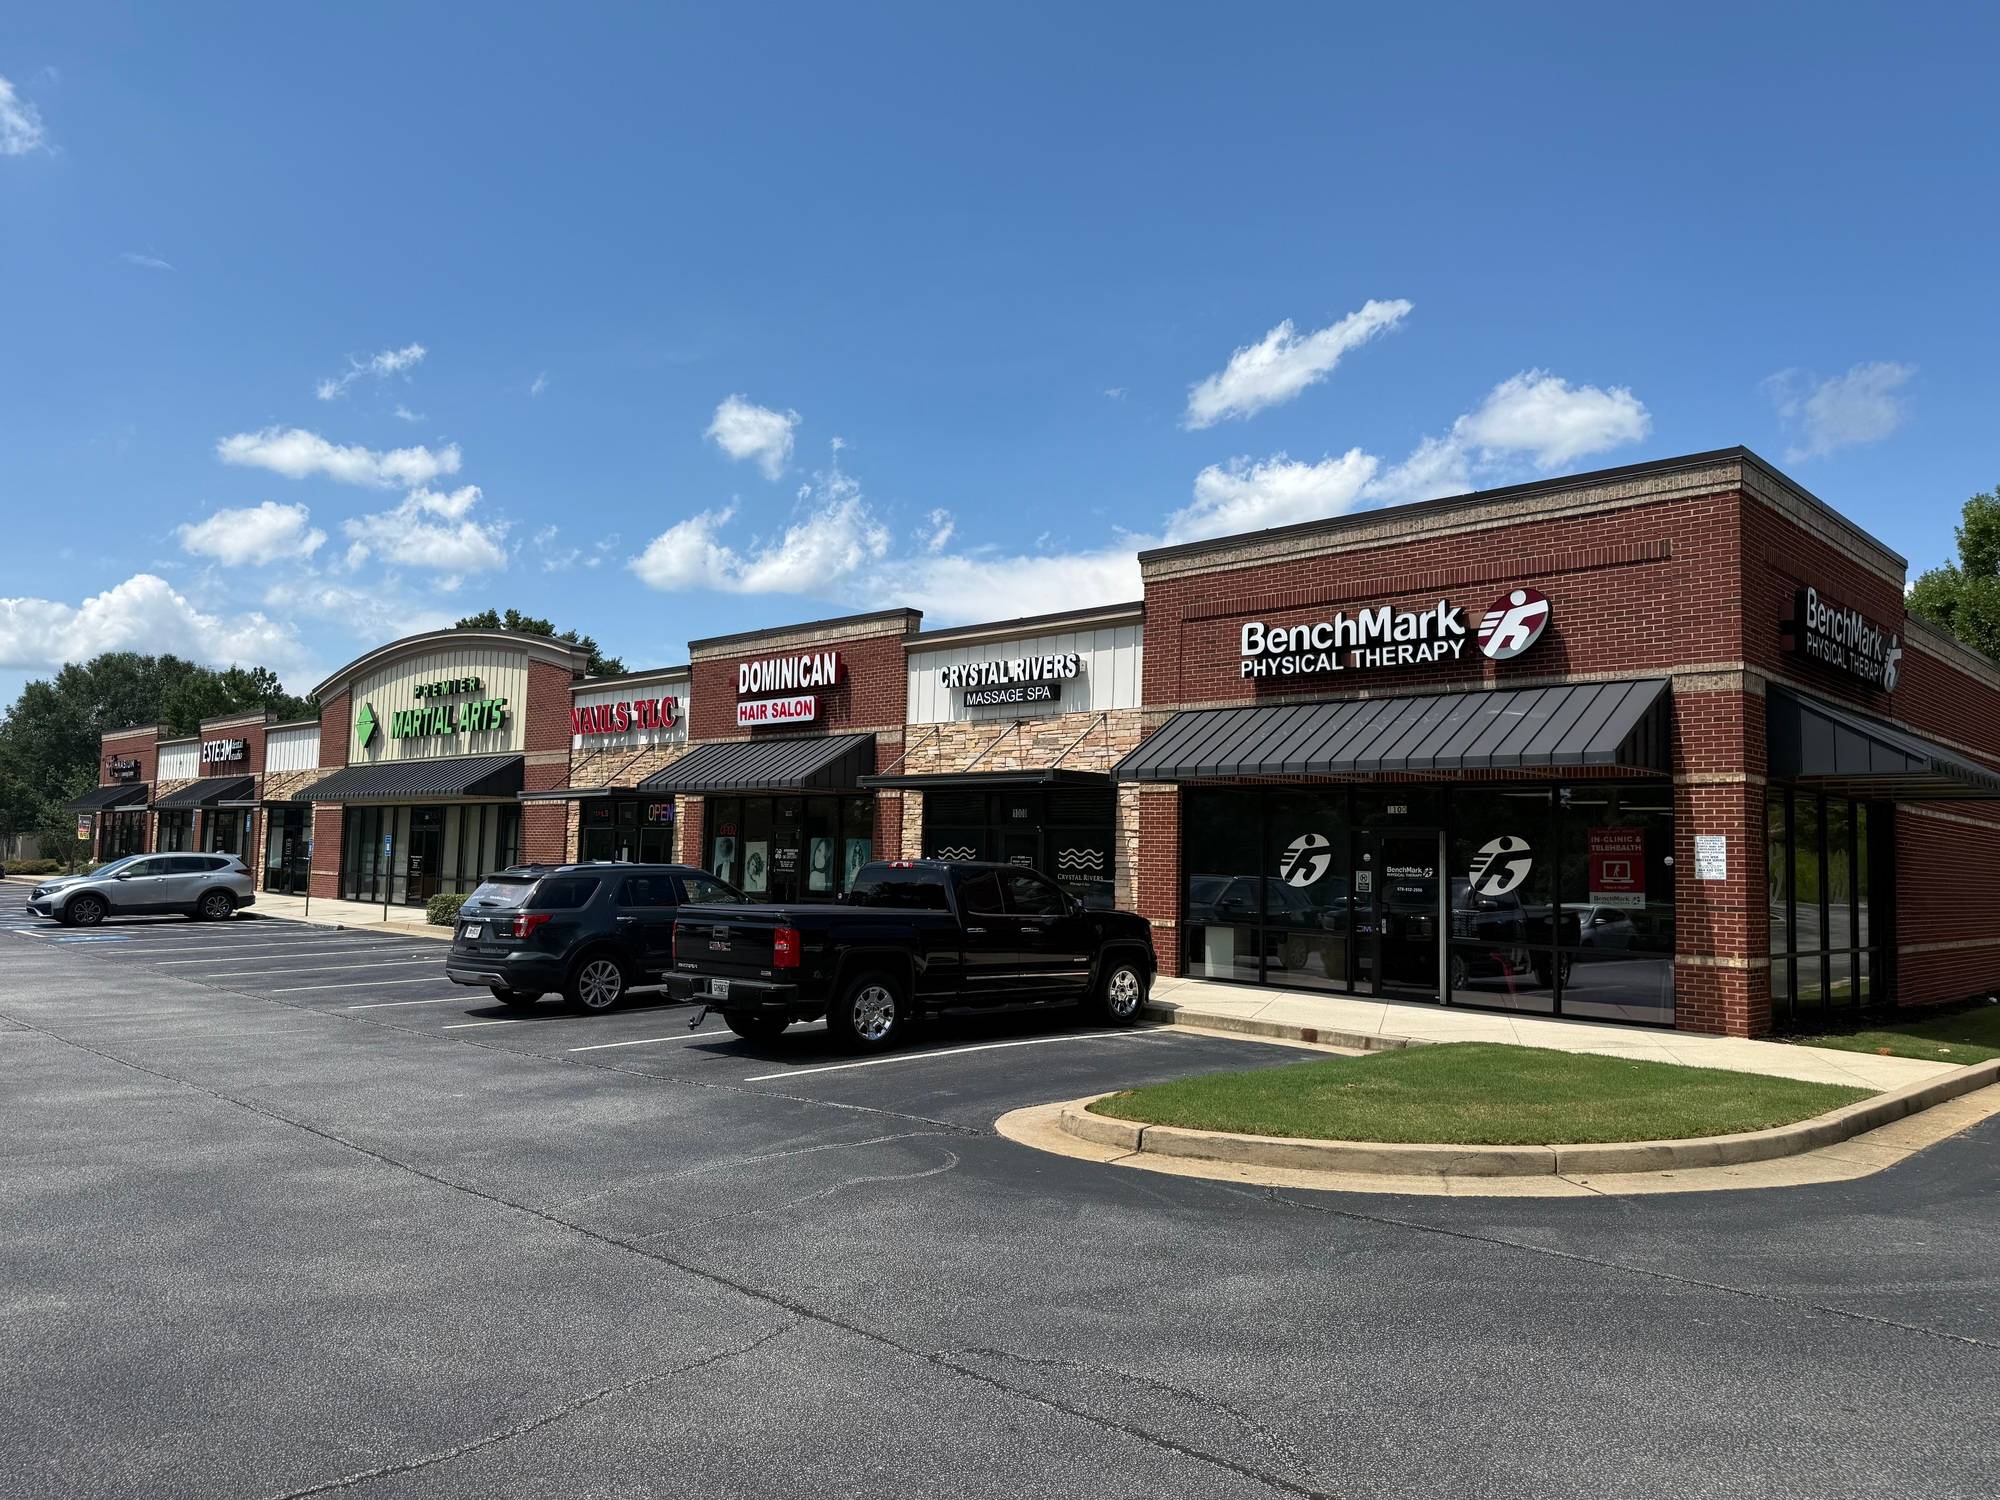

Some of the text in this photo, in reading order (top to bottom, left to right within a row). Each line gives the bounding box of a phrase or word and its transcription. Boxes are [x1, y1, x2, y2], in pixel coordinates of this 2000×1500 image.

[1241, 599, 1465, 656] BenchMark
[1807, 586, 1882, 661] BenchMark
[739, 652, 836, 694] DOMINICAN
[940, 653, 1077, 688] CRYSTAL RIVERS
[1241, 639, 1466, 678] PHYSICAL THERAPY
[1807, 632, 1884, 684] PHYSICAL THERAPY
[415, 677, 476, 696] PREMIER
[966, 685, 1051, 705] MASSAGE SPA
[391, 698, 504, 738] MARTIAL ARTS
[569, 696, 677, 735] NAILS TLC
[739, 700, 812, 721] HAIR SALON
[648, 803, 675, 821] OPEN
[1591, 844, 1642, 852] TELEHEALTH
[1057, 873, 1104, 881] CRYSTAL RIVERS
[1386, 866, 1423, 874] BenchMark
